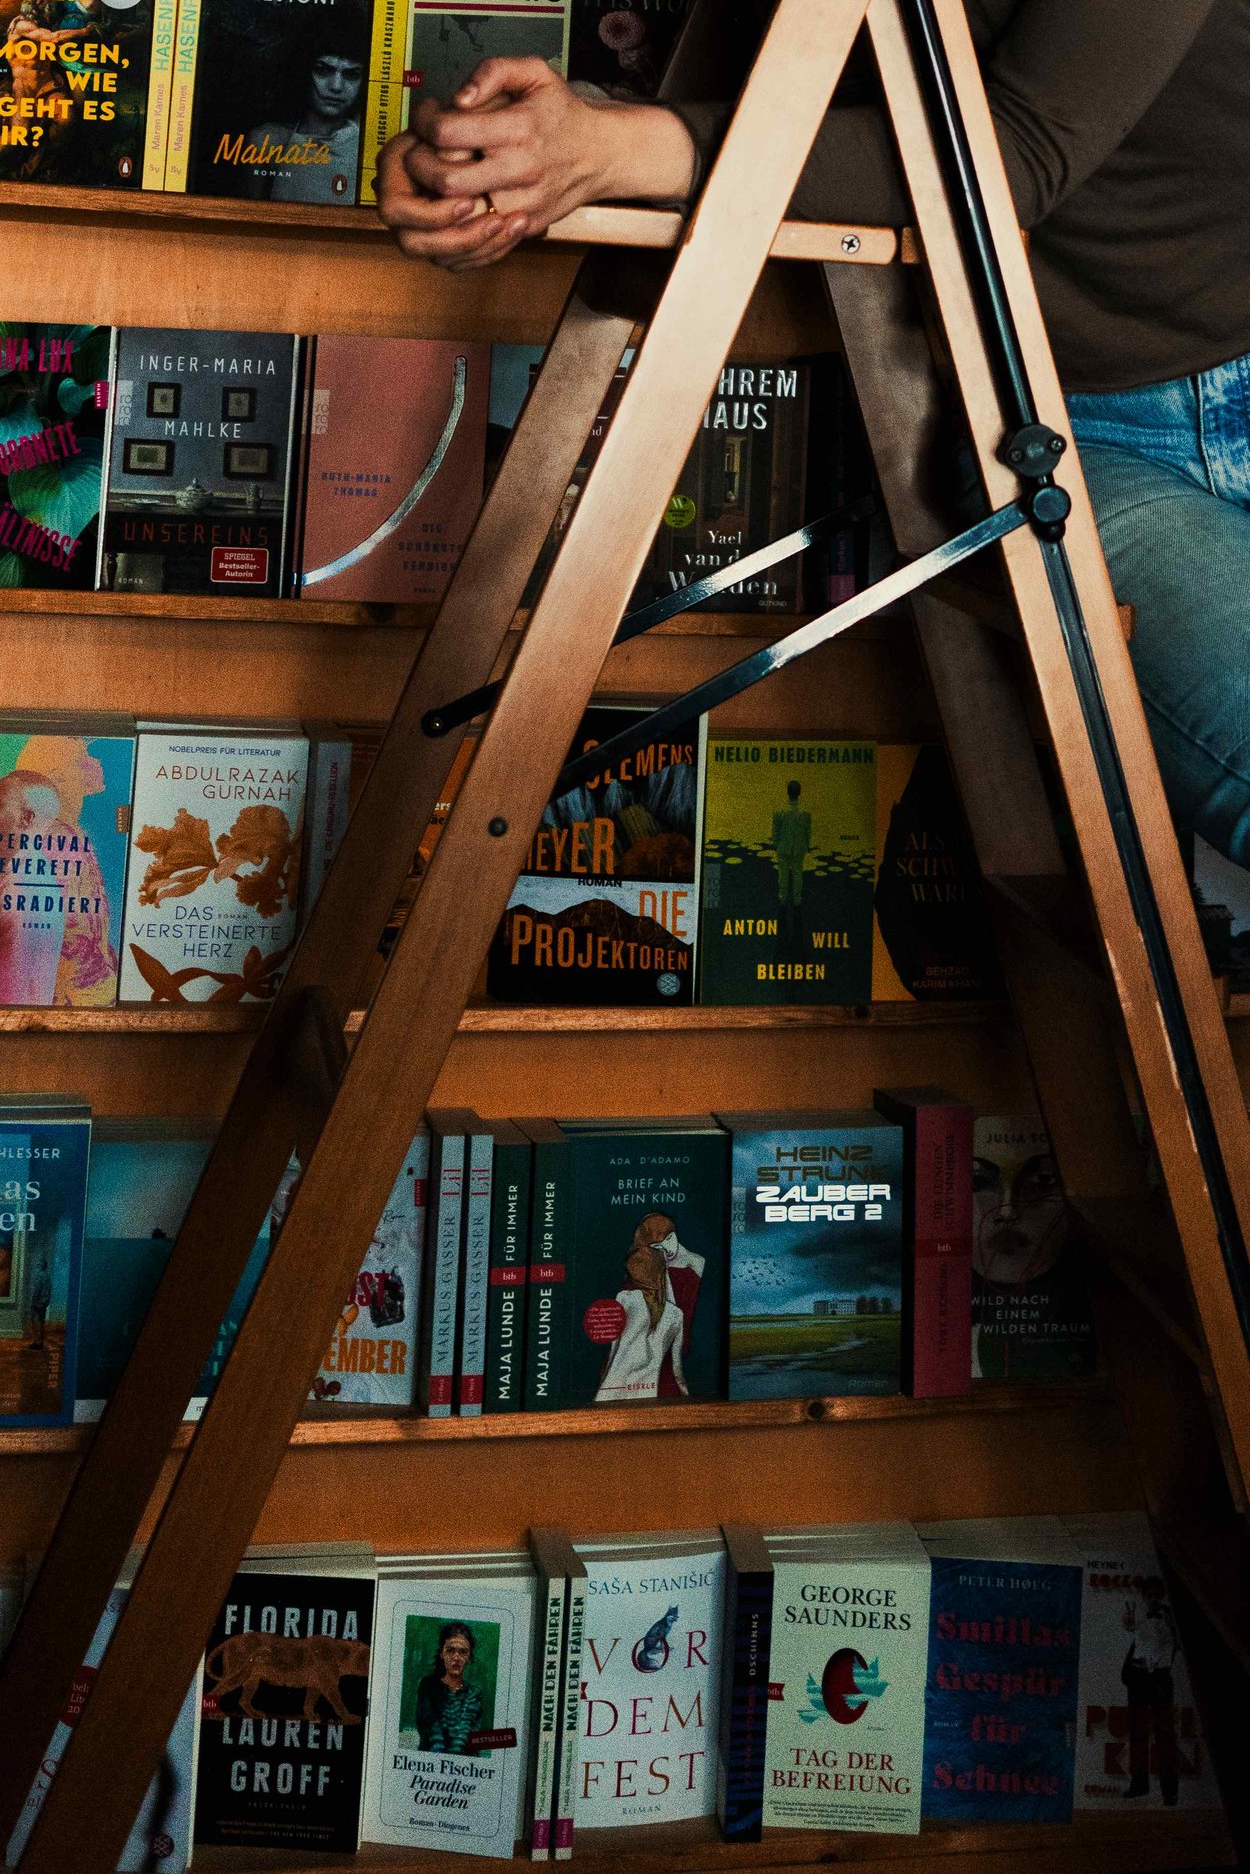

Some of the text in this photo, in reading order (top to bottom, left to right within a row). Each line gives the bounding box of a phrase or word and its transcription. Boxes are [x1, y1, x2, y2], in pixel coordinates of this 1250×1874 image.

[66, 70, 118, 93] WIE
[82, 100, 116, 122] ES
[212, 133, 333, 166] Malnata
[253, 169, 292, 178] ROMAN
[38, 336, 75, 373] LUX
[140, 354, 276, 376] INGER-MARIA
[164, 420, 242, 439] MAHLKE
[332, 486, 378, 498] THOMAS
[124, 522, 268, 546] UNSEREINS
[707, 530, 742, 544] Yael
[224, 552, 256, 562] SPIEGEL
[218, 562, 260, 572] Bestseller-
[224, 570, 254, 578] Autorin
[168, 745, 282, 757] NOBELPREIS FÜR LITERATUR
[714, 746, 876, 764] NELIO BIEDERMANN
[156, 765, 300, 785] ABDULRAZAK
[202, 784, 291, 802] GURNAH
[175, 905, 214, 921] DAS
[638, 890, 688, 937] DIE
[22, 922, 51, 930] ROMAN
[132, 922, 282, 942] VERSTEINERTE
[722, 918, 778, 936] ANTON
[511, 914, 688, 971] PROJEKTOREN
[812, 931, 850, 948] WILL
[182, 942, 233, 959] HERZ
[757, 964, 826, 980] BLEIBEN
[926, 966, 970, 976] BEHZAD
[912, 980, 946, 989] KARIM
[609, 1156, 690, 1166] ADA D'ADAMO
[775, 1144, 874, 1163] HEINZ
[618, 1177, 680, 1190] BRIEF AN
[610, 1192, 686, 1204] MEIN KIND
[755, 1183, 892, 1204] ZAUBER
[544, 1181, 556, 1228] IMMER
[764, 1204, 856, 1223] BERG
[506, 1184, 518, 1262] FÜR IMMER
[502, 1272, 516, 1280] btb
[540, 1269, 554, 1278] btb
[996, 1310, 1040, 1320] EINEM
[498, 1291, 514, 1400] MAJA LUNDE
[536, 1288, 552, 1396] MAJA LUNDE
[800, 1584, 897, 1608] GEORGE
[224, 1604, 358, 1640] FLORIDA
[784, 1606, 912, 1632] SAUNDERS
[586, 1628, 710, 1675] VOR
[748, 1612, 759, 1676] DSCHINNS
[202, 1698, 218, 1708] btb
[584, 1693, 704, 1738] DEM
[222, 1716, 344, 1752] LAUREN
[392, 1755, 495, 1781] Elena Fischer
[789, 1748, 894, 1772] TAG DER
[230, 1760, 331, 1798] GROFF
[408, 1775, 476, 1796] Paradise
[580, 1752, 705, 1800] FEST
[772, 1770, 912, 1795] BEFREIUNG
[414, 1791, 469, 1810] Garden
[408, 1817, 434, 1827] Roman
